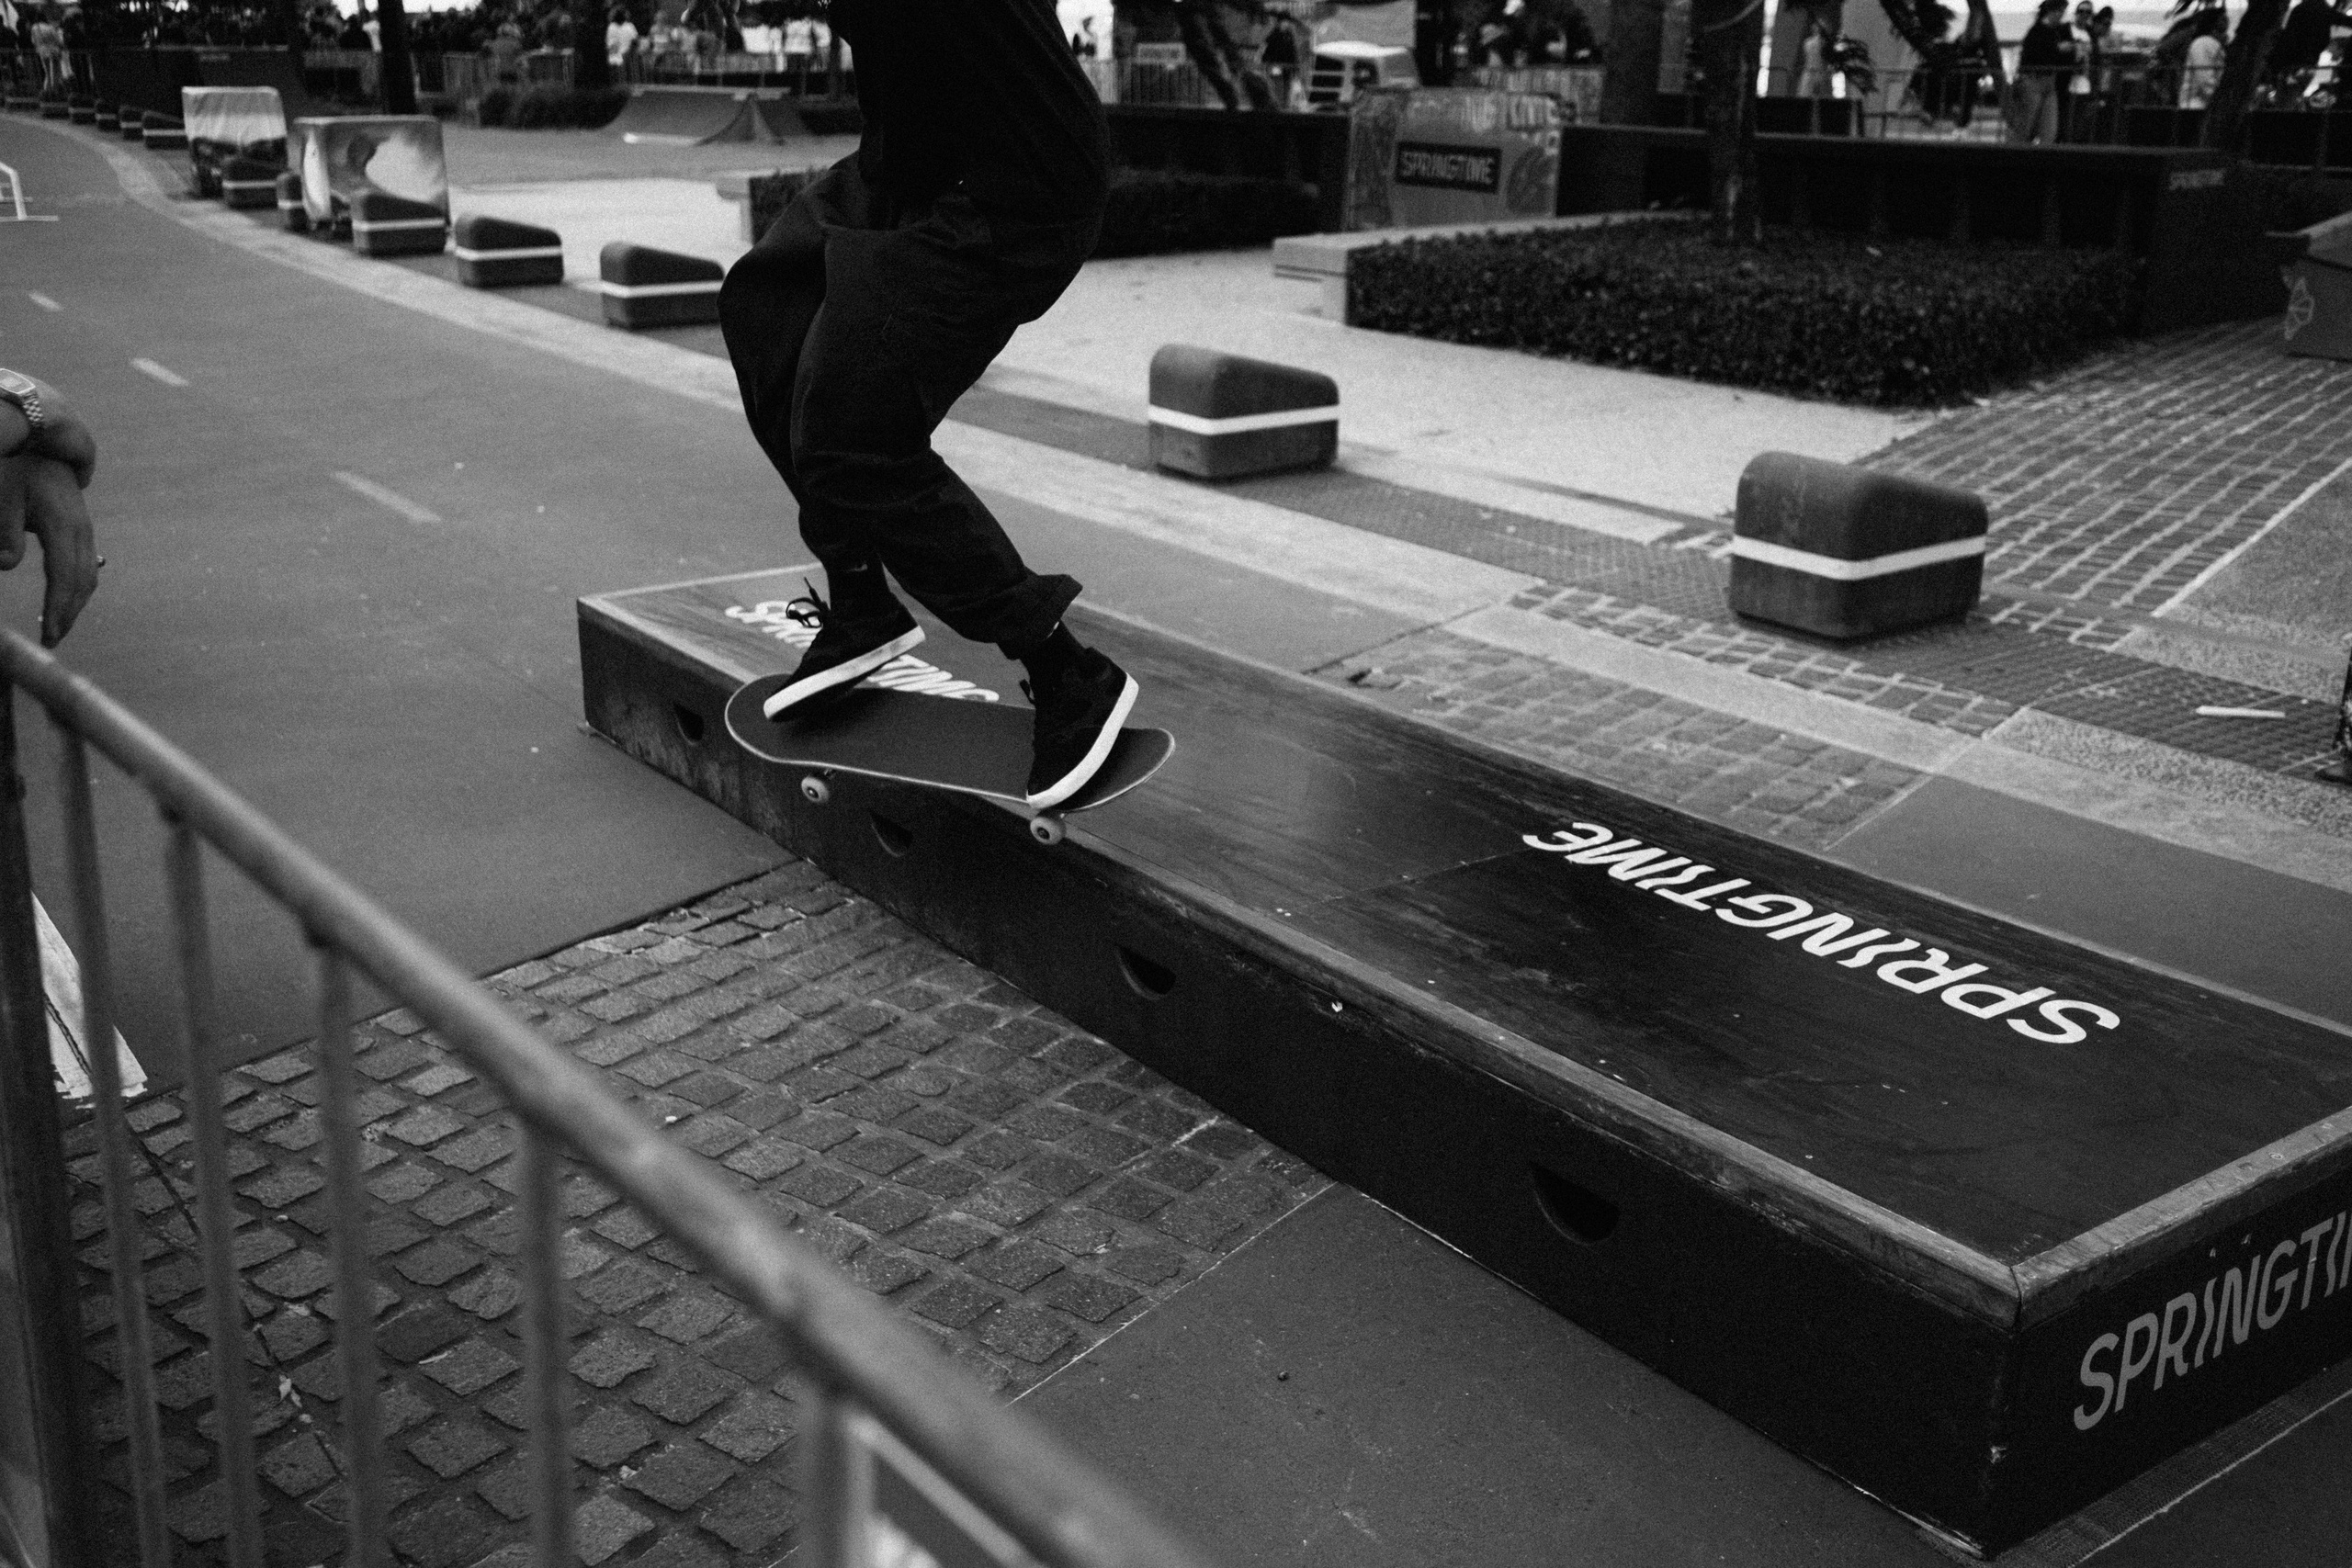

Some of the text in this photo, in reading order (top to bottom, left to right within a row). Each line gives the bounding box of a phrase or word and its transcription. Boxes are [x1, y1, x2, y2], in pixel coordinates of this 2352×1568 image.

[1400, 150, 1495, 185] SPRINGTIME
[1521, 821, 2121, 1045] SPRINGTIME
[2073, 1210, 2352, 1431] SPRINGTI
